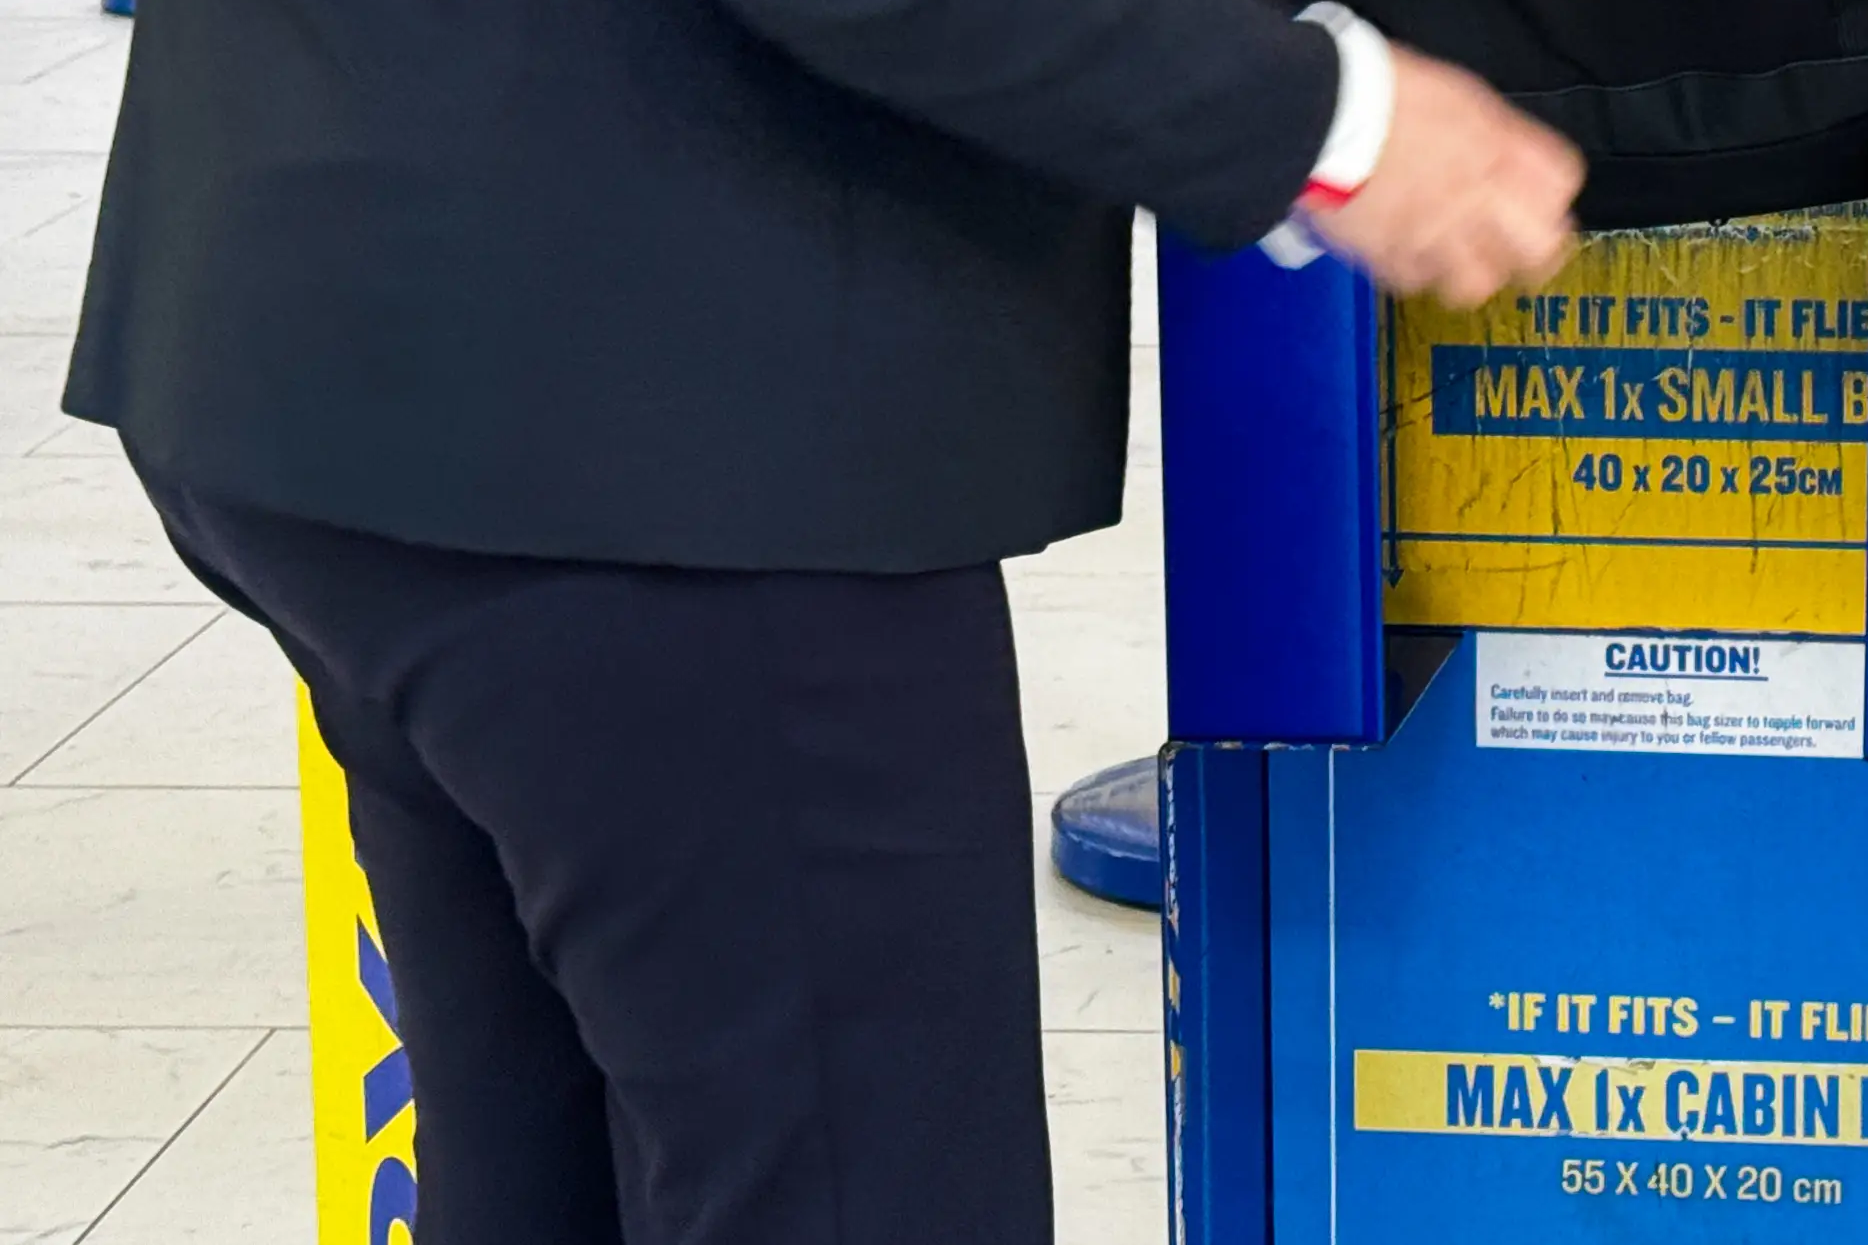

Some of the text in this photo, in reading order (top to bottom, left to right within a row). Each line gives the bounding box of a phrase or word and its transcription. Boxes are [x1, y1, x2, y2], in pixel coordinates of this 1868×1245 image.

[1579, 295, 1615, 336] IT
[1627, 296, 1709, 338] FITS
[1745, 298, 1781, 338] IT
[1475, 365, 1585, 420] MAX
[1600, 365, 1644, 421] 1x
[1657, 367, 1828, 424] SMALL
[1573, 453, 1623, 492] 40
[1633, 464, 1651, 493] x
[1661, 455, 1710, 493] 20
[1720, 466, 1739, 494] x
[1605, 642, 1760, 675] CAUTION!
[1491, 684, 1548, 703] Carefully
[1551, 688, 1588, 702] insert
[1591, 689, 1614, 703] and
[1617, 691, 1664, 703] remove
[1490, 706, 1534, 722] Failure
[1536, 708, 1549, 722] to
[1553, 709, 1568, 722] do
[1572, 712, 1586, 724] so
[1660, 708, 1683, 726] this
[1687, 712, 1710, 729] bag
[1714, 715, 1742, 727] sizer
[1746, 715, 1760, 728] to
[1763, 715, 1802, 732] topple
[1806, 715, 1855, 731] forward
[1490, 725, 1817, 750] which may cause injury to you or fellow passengers.
[1557, 994, 1596, 1033] IT
[1608, 996, 1698, 1037] FITS
[1749, 1000, 1790, 1039] IT
[1446, 1063, 1572, 1131] MAX
[1664, 1070, 1840, 1140] CABIN
[1561, 1159, 1842, 1205] 55 X 40 X 20 cm
